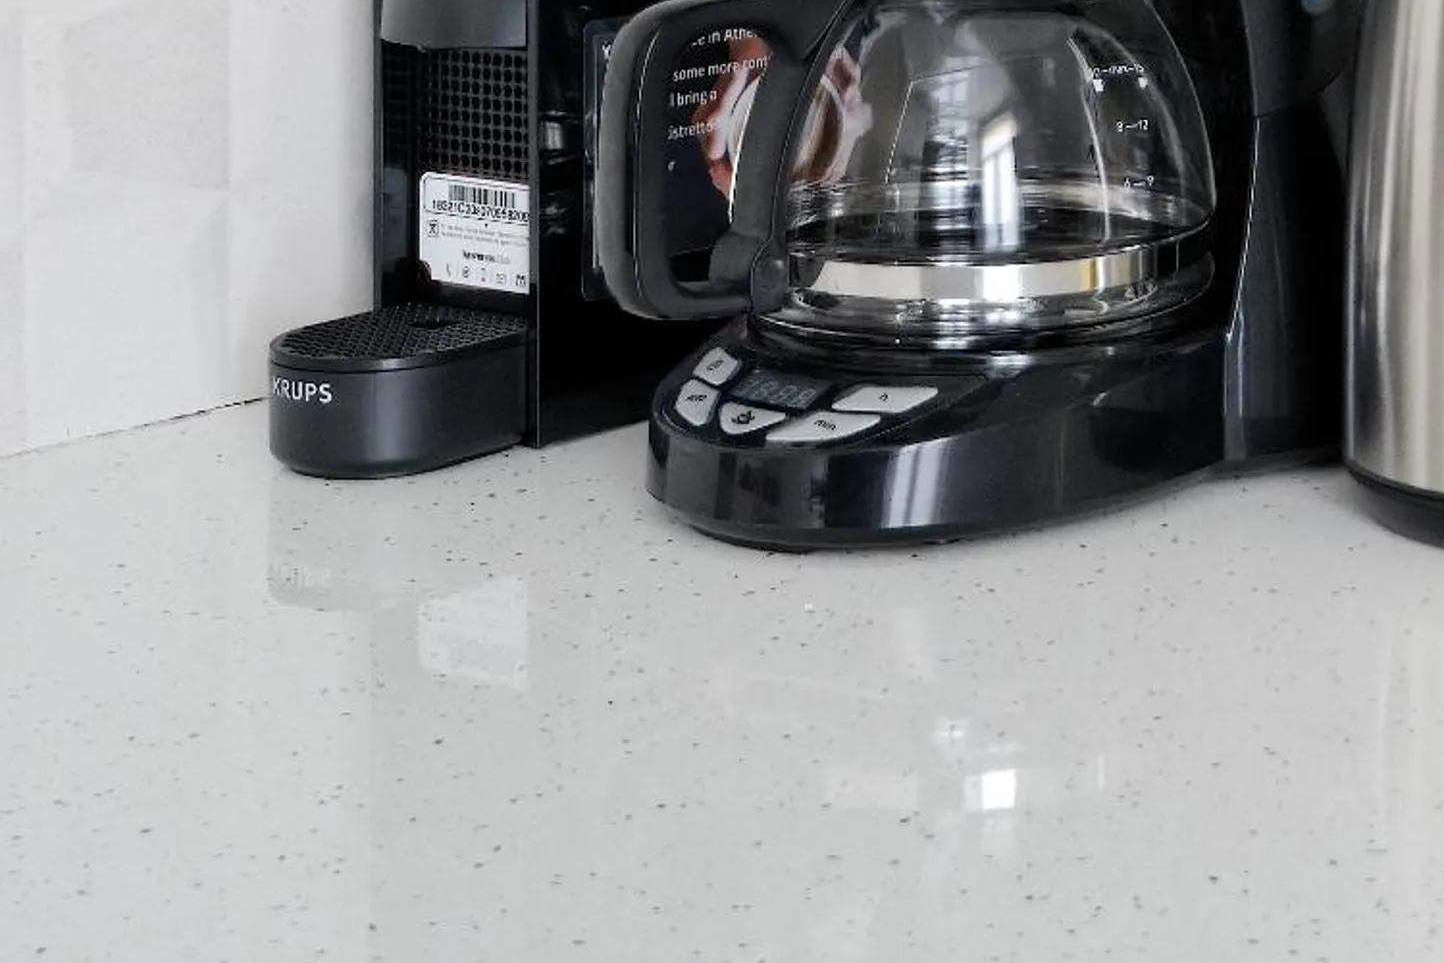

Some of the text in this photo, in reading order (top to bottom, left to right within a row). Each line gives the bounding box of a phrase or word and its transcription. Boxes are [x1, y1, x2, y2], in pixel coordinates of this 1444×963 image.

[723, 27, 759, 42] Athe
[672, 55, 771, 82] some more com
[677, 90, 708, 107] bring
[667, 121, 714, 140] istretto
[272, 376, 333, 404] KRUPS
